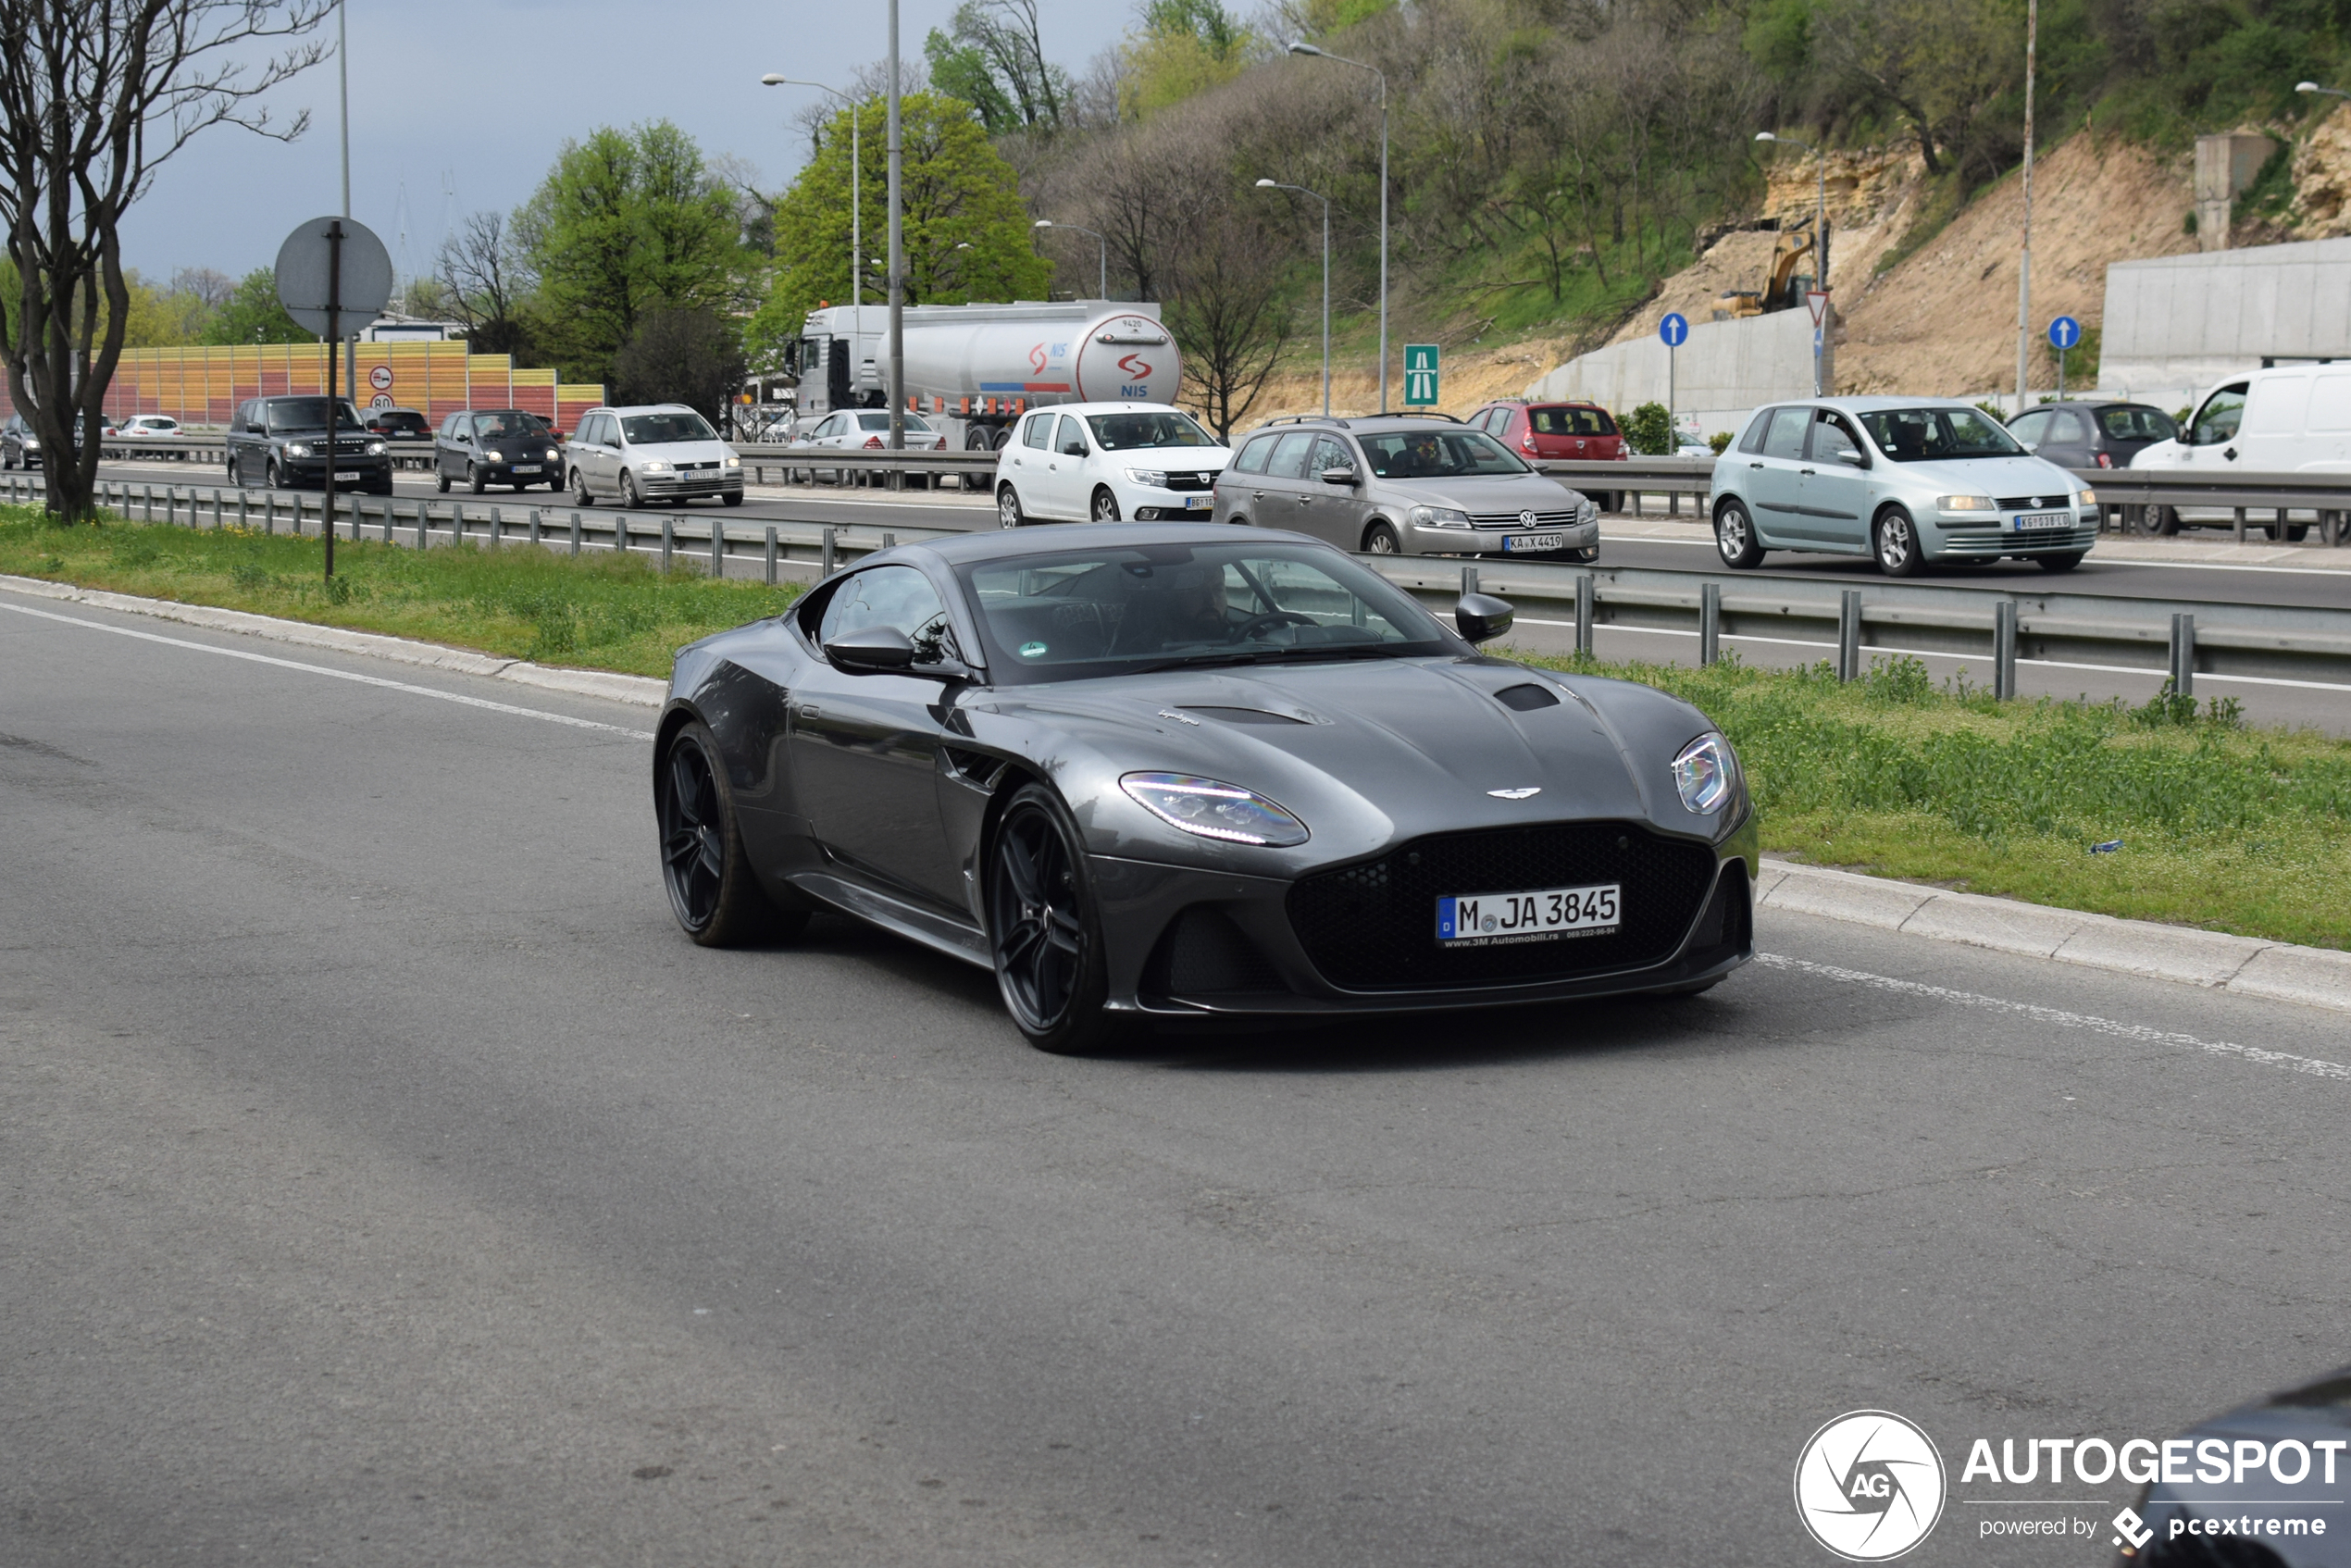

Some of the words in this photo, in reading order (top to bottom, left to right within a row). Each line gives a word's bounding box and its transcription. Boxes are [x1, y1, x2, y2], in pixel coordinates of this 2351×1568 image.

[1123, 319, 1142, 328] 9420
[1050, 342, 1067, 357] NIS
[1121, 385, 1148, 397] NIS
[375, 398, 390, 407] 80
[1191, 498, 1200, 507] BG
[2021, 516, 2034, 528] KG
[1510, 538, 1524, 549] KA
[1530, 537, 1536, 547] X
[1538, 535, 1561, 547] 4419
[1460, 900, 1478, 932] M
[1500, 896, 1537, 929] JA
[1546, 889, 1616, 926] 3845
